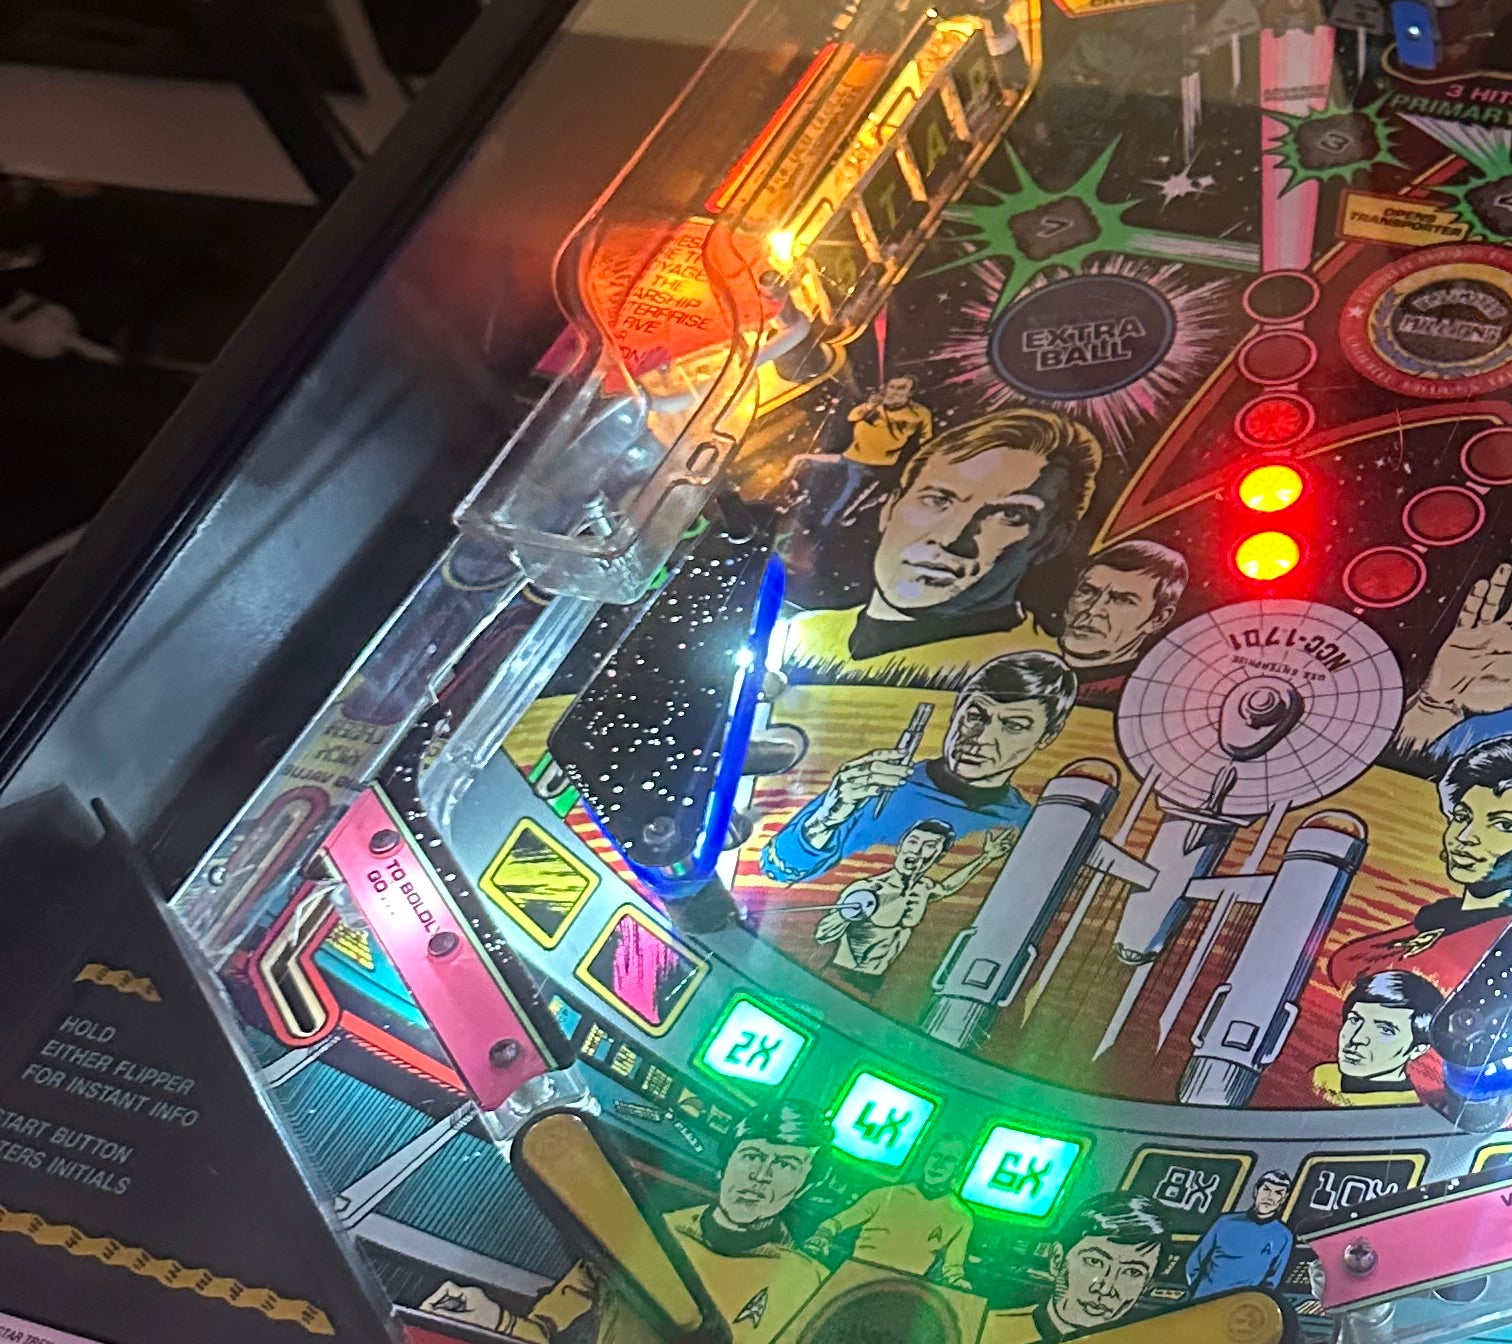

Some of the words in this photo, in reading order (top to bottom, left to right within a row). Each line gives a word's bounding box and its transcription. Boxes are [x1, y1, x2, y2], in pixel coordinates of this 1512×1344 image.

[1445, 83, 1463, 98] 3
[1320, 132, 1350, 153] 3
[1349, 210, 1462, 237] TRANSPORTER
[1382, 207, 1438, 224] OPENS
[1022, 316, 1146, 353] EXTRA
[1036, 336, 1132, 371] BALL
[1229, 626, 1351, 672] NCC-1701
[386, 859, 407, 882] TO
[59, 1016, 116, 1043] HOLD
[40, 1039, 113, 1073] EITHER
[115, 1060, 195, 1096] FLIPPER
[726, 1030, 782, 1071] 2X
[21, 1064, 66, 1088] FOR
[66, 1076, 151, 1112] INSTANT
[149, 1101, 199, 1127] INFO
[853, 1101, 912, 1149] 4X
[50, 1127, 134, 1164] BUTTON
[47, 1156, 131, 1195] INITIALS
[991, 1149, 1053, 1193] 6X
[1152, 1164, 1220, 1213] 8X
